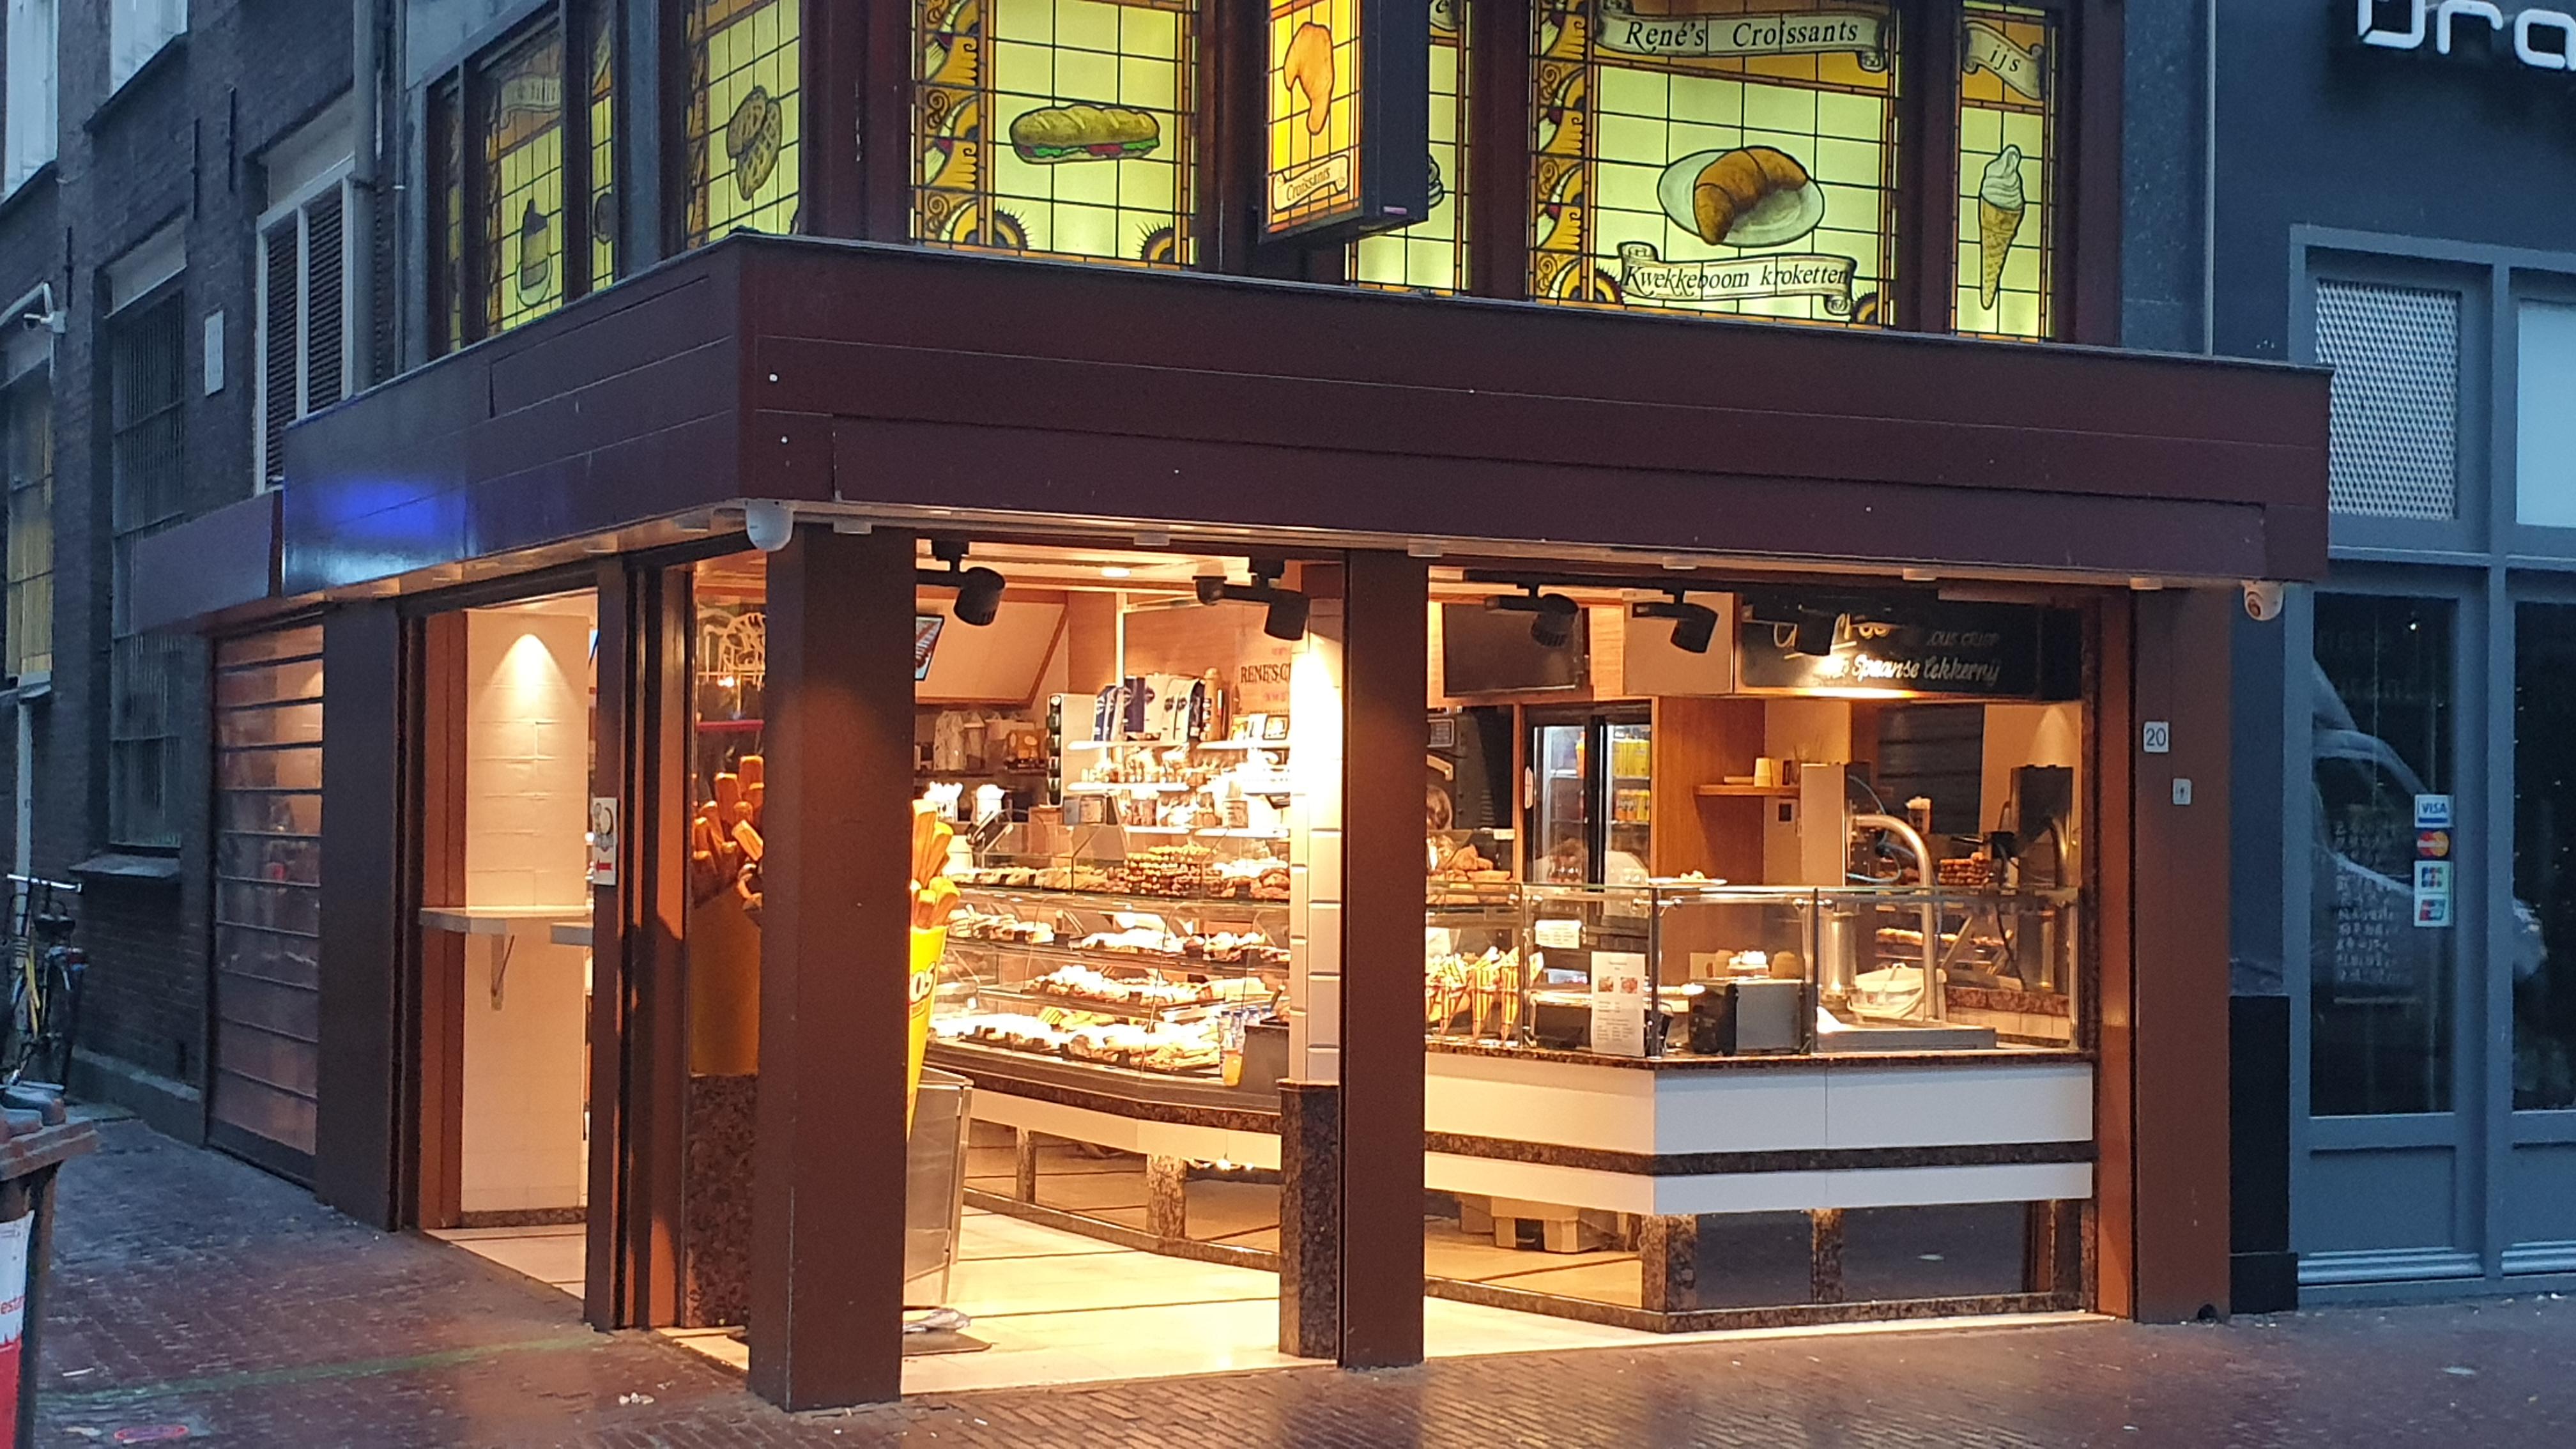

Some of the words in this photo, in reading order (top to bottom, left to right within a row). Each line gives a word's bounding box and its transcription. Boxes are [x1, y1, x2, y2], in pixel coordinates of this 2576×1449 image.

[1625, 20, 1705, 53] René's
[1733, 20, 1859, 47] Croissants
[1989, 44, 2021, 72] ijs
[1623, 265, 1749, 296] Kwekkeboom
[1759, 263, 1848, 286] kroketten
[2145, 727, 2166, 746] 20
[2421, 802, 2448, 814] VISA
